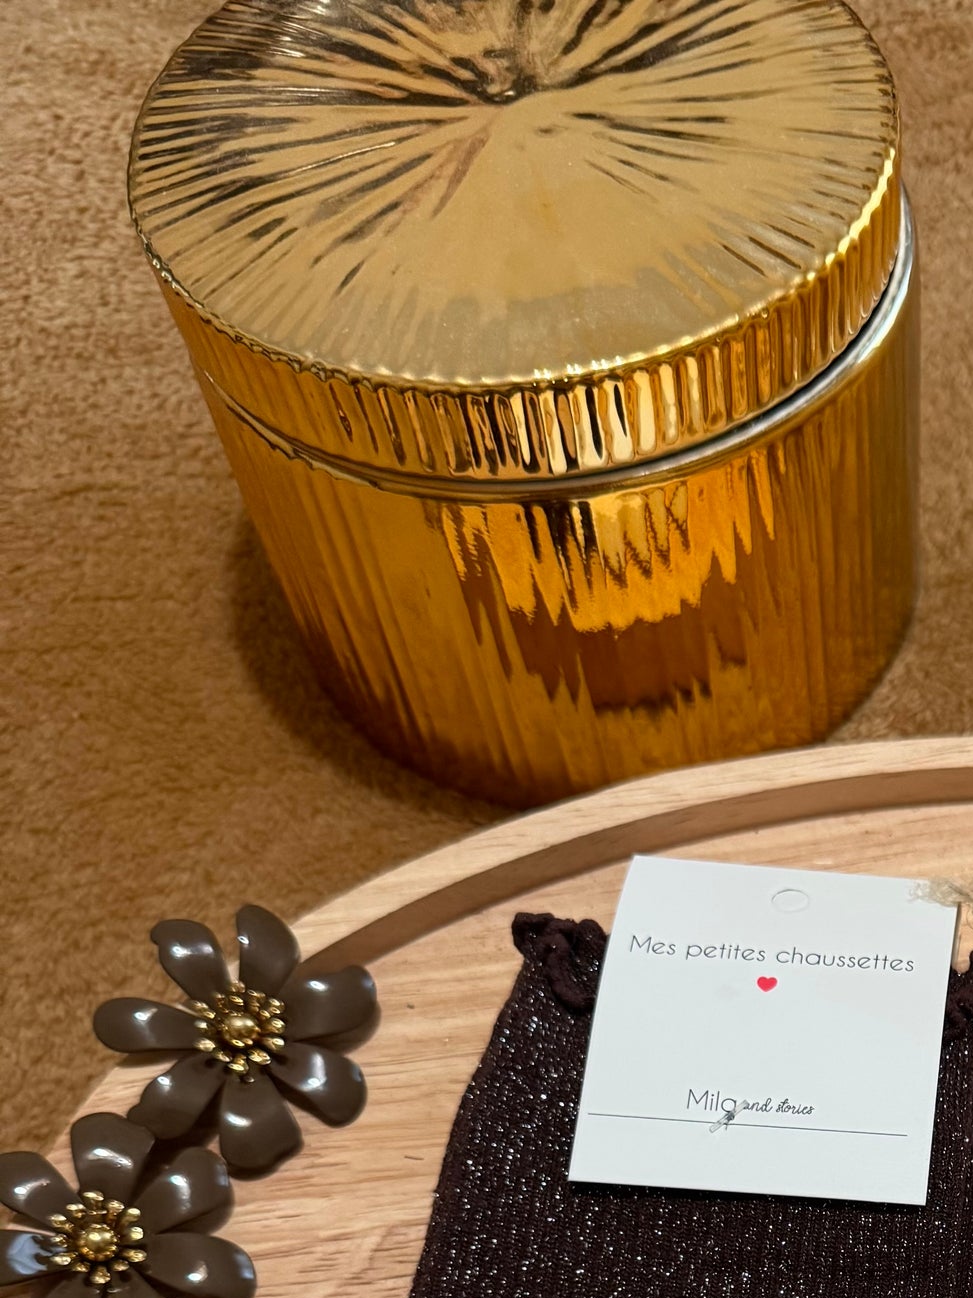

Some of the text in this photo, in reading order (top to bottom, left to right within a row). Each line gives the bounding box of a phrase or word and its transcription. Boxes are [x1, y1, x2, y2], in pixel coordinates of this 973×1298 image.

[629, 934, 915, 972] Mes petites chaussettes
[686, 1088, 738, 1113] Mila
[775, 1097, 815, 1116] stories
